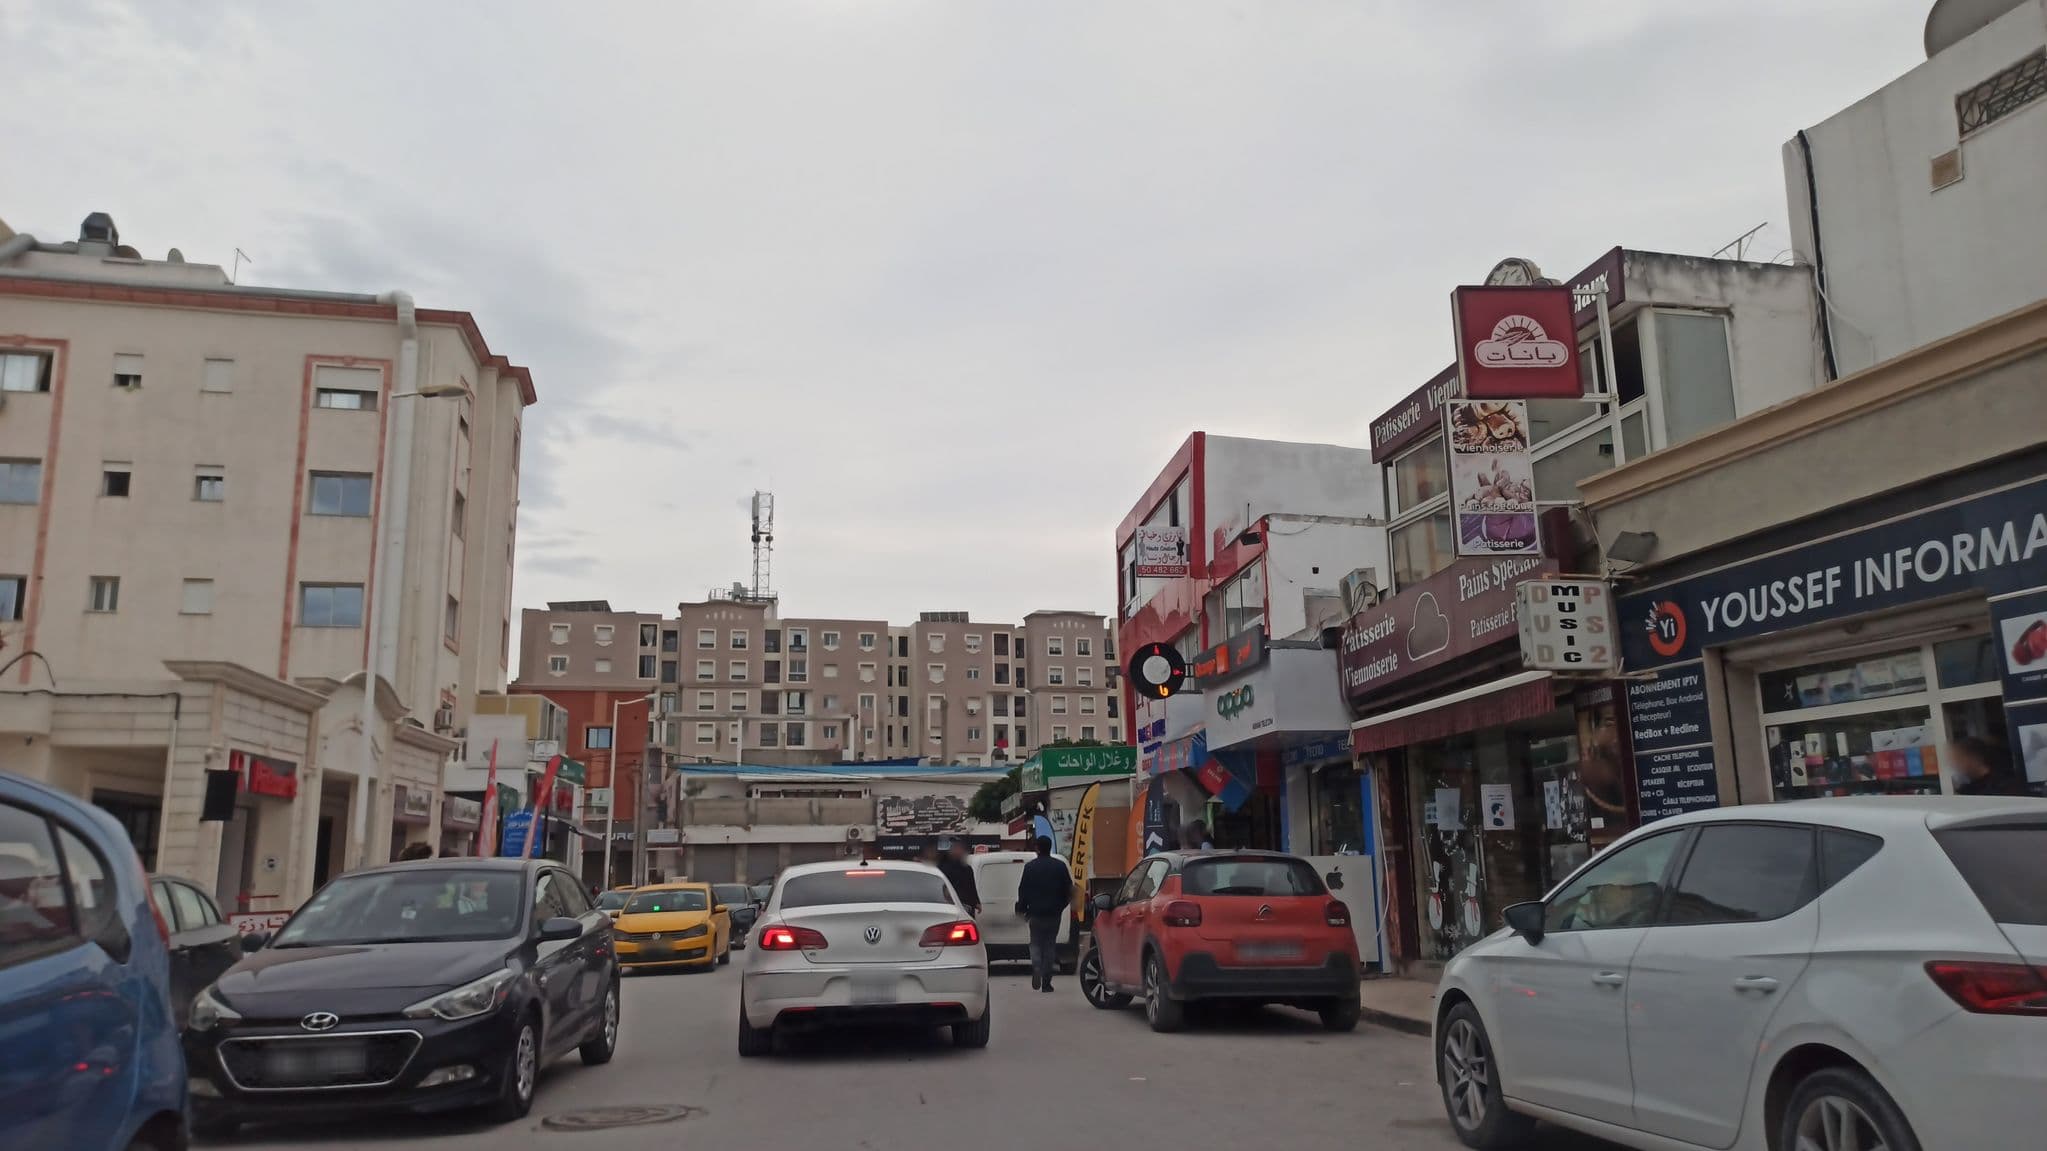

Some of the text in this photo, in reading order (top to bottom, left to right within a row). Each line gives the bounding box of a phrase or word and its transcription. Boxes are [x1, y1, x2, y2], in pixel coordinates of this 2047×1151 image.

[1486, 346, 1557, 363] بانات
[1460, 443, 1524, 453] Viennoiserie
[1459, 569, 1490, 602] Pains
[1700, 566, 1842, 633] YOUSSEF
[1551, 585, 1583, 663] MUSIC
[1583, 586, 1609, 663] PS2
[1345, 648, 1398, 687] Viennoiserie
[1630, 675, 1698, 695] ABONNEMENT IPTV
[1217, 684, 1255, 722] oppo
[1678, 691, 1704, 703] Android
[1633, 715, 1639, 723] et
[1634, 728, 1662, 740] RedBox
[1670, 723, 1699, 735] Redline
[1058, 753, 1097, 772] الواحات
[1099, 750, 1122, 770] غلال
